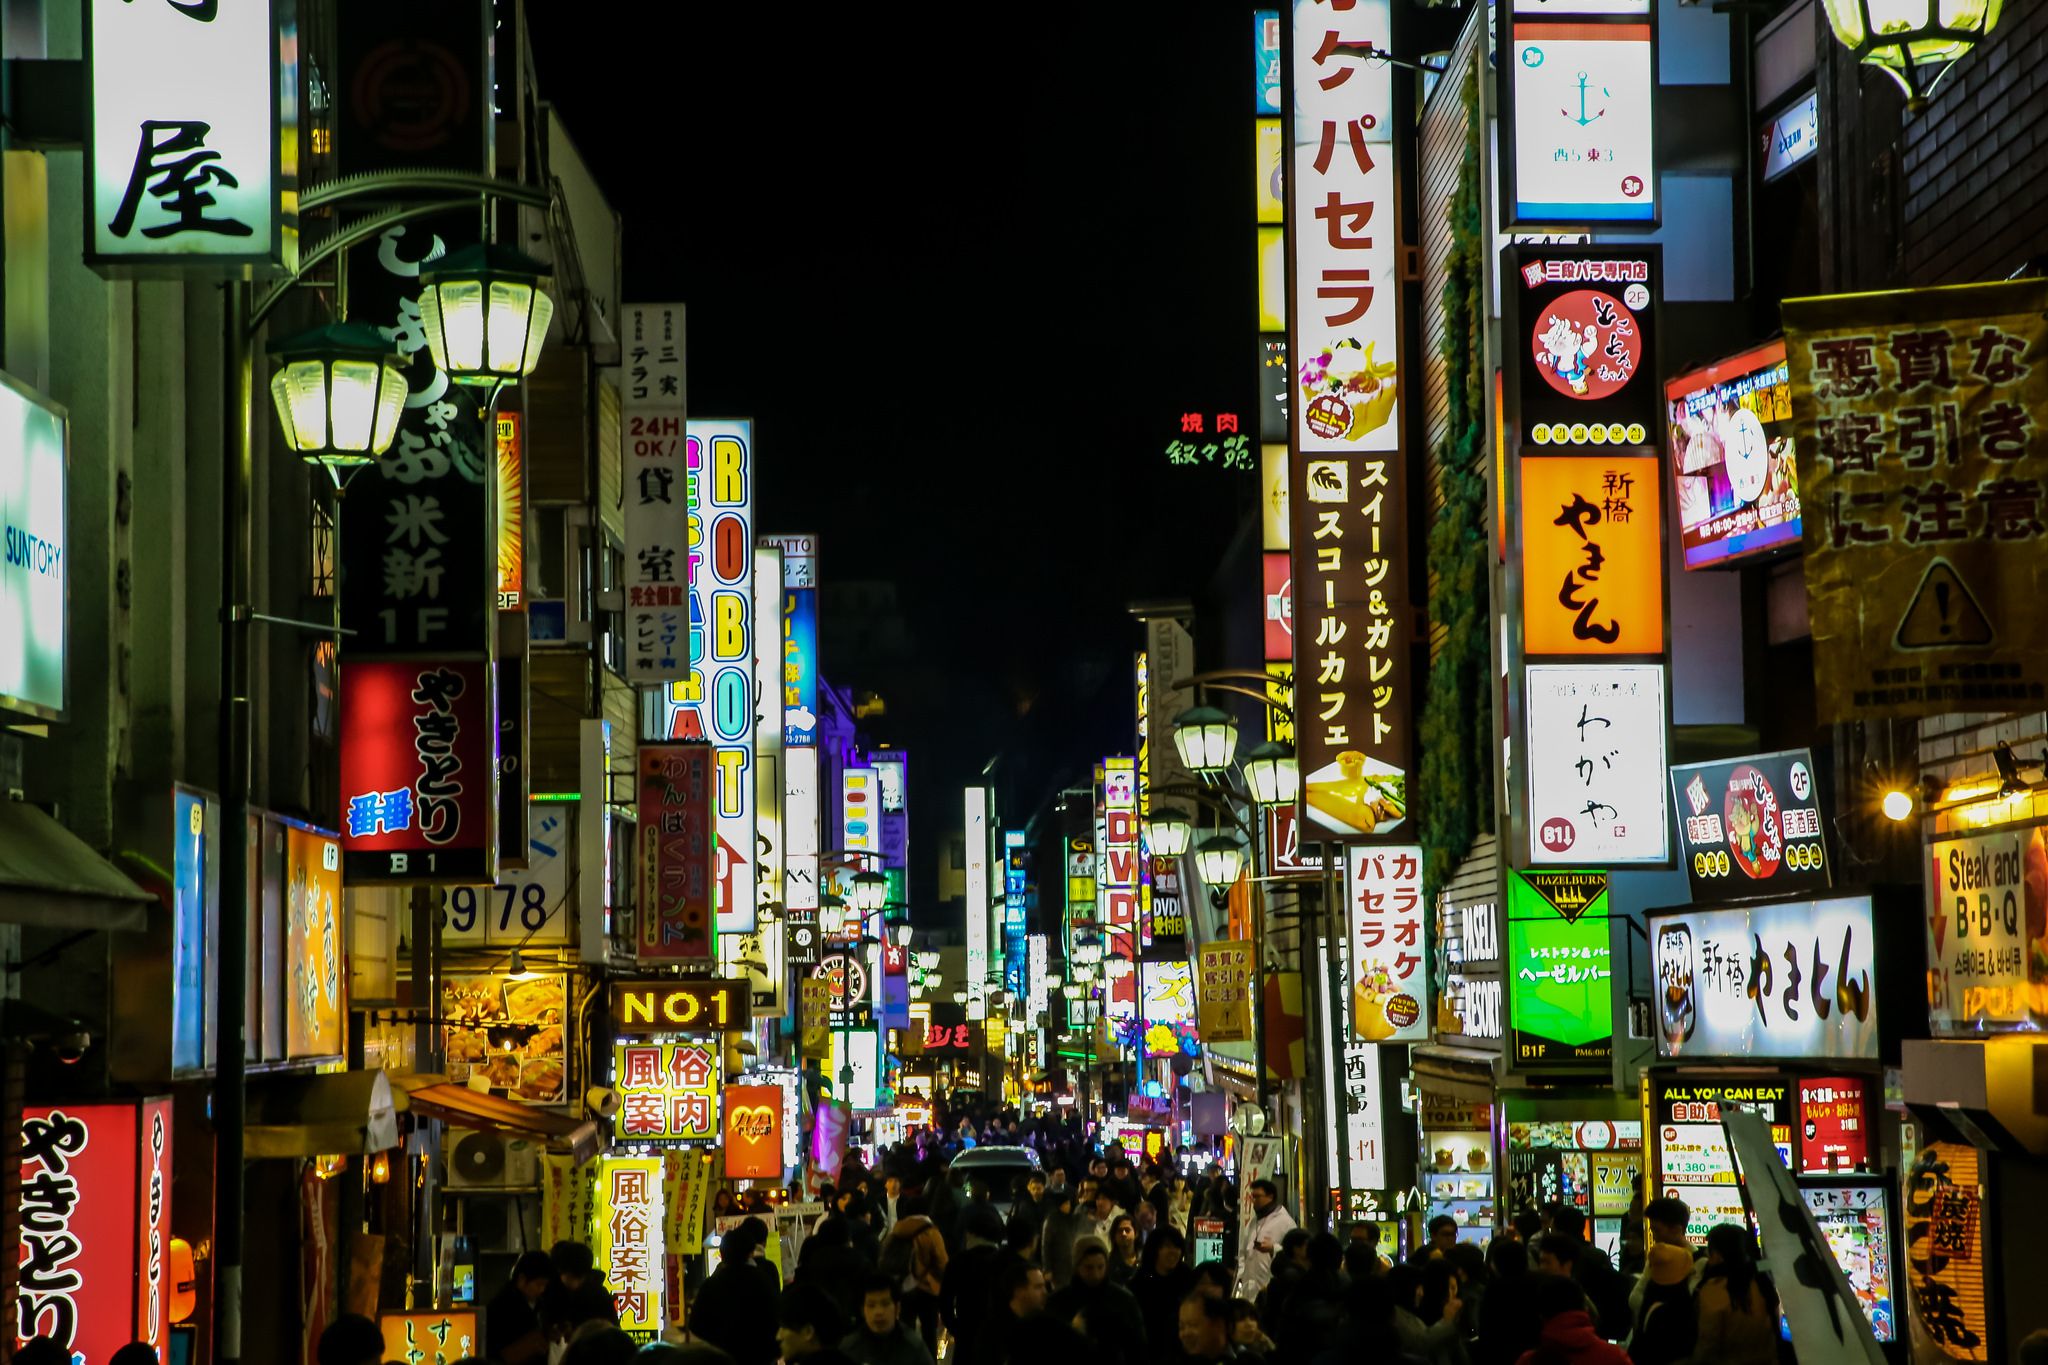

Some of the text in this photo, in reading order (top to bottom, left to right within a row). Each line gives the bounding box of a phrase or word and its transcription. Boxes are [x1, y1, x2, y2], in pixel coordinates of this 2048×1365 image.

[1312, 0, 1377, 327] ケパセラ
[1624, 179, 1640, 194] 3F
[1627, 290, 1646, 304] 2F
[1809, 325, 2032, 400] 悪質な
[630, 417, 679, 436] 24H
[1181, 412, 1239, 433] 焼肉
[1815, 402, 2034, 475] 客引き
[1602, 461, 1635, 524] 新橋
[1825, 478, 2046, 549] に注意
[6, 524, 61, 579] SUNTORY
[1553, 492, 1621, 645] やきとん
[378, 608, 449, 644] 1F
[711, 436, 751, 818] ROBOT
[1313, 510, 1349, 745] スコールカフェ
[412, 667, 466, 845] やきとり
[1575, 704, 1619, 828] わがや
[1793, 771, 1808, 793] 2F
[1536, 875, 1607, 886] HAZELBURN
[1949, 840, 2019, 892] Steak and
[1357, 854, 1385, 948] パセラ
[1392, 854, 1421, 980] カラオケ
[1204, 951, 1246, 966] 悪質な
[1462, 903, 1499, 962] PASELA
[1204, 970, 1246, 985] 客引き
[1519, 963, 1611, 984] ヘーゼルバー
[1702, 924, 1870, 1028] 新橋 やきとん
[1988, 948, 1995, 977] &
[622, 1046, 712, 1091] 風俗
[1521, 1045, 1546, 1057] B1F
[623, 1090, 711, 1135] 案内
[1664, 1088, 1691, 1100] ALL
[1724, 1088, 1754, 1100] CAN
[1756, 1088, 1784, 1100] EAT
[20, 1111, 88, 1351] やきとり
[608, 1169, 651, 1325] 風俗案内
